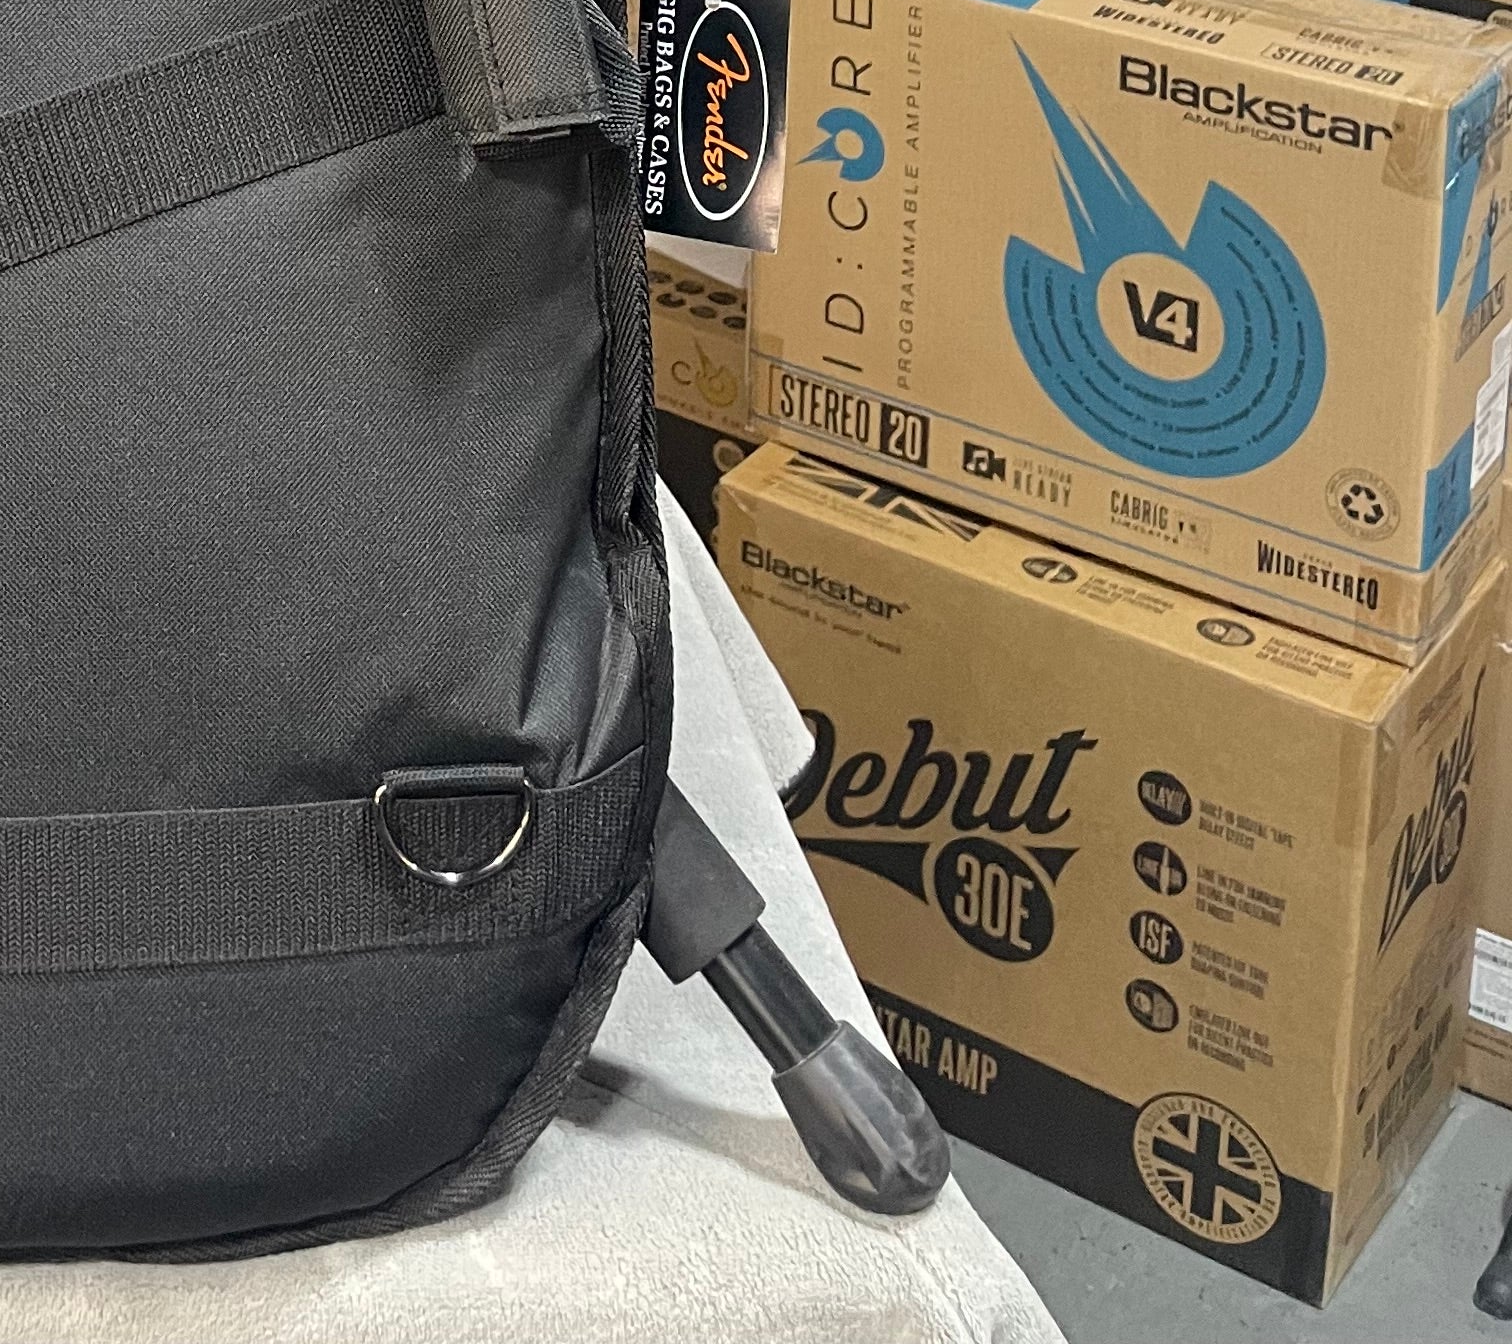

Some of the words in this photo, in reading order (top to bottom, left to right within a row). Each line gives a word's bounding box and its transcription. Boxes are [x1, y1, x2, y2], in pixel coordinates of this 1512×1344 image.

[639, 21, 654, 67] Protect
[654, 40, 675, 111] BAGS
[907, 4, 924, 153] AMPLIFIER
[1271, 44, 1353, 75] STEREO
[652, 112, 671, 130] &
[696, 32, 751, 191] Fender
[1118, 54, 1395, 153] Blackstar
[1181, 111, 1325, 155] AMPLIFICATION
[644, 133, 671, 216] CASES
[897, 164, 921, 392] PROGRAMMABLE
[1122, 279, 1200, 354] V4
[779, 377, 872, 446] STEREO
[886, 412, 924, 465] 20
[1012, 470, 1072, 508] READY
[1110, 489, 1170, 531] CABRIG
[741, 540, 905, 619] Blackstar
[1257, 539, 1380, 611] WIDESTEREO
[954, 852, 1035, 952] 30E
[1139, 915, 1174, 959] ISF
[876, 1005, 931, 1069] TAR
[938, 1037, 998, 1095] AMP
